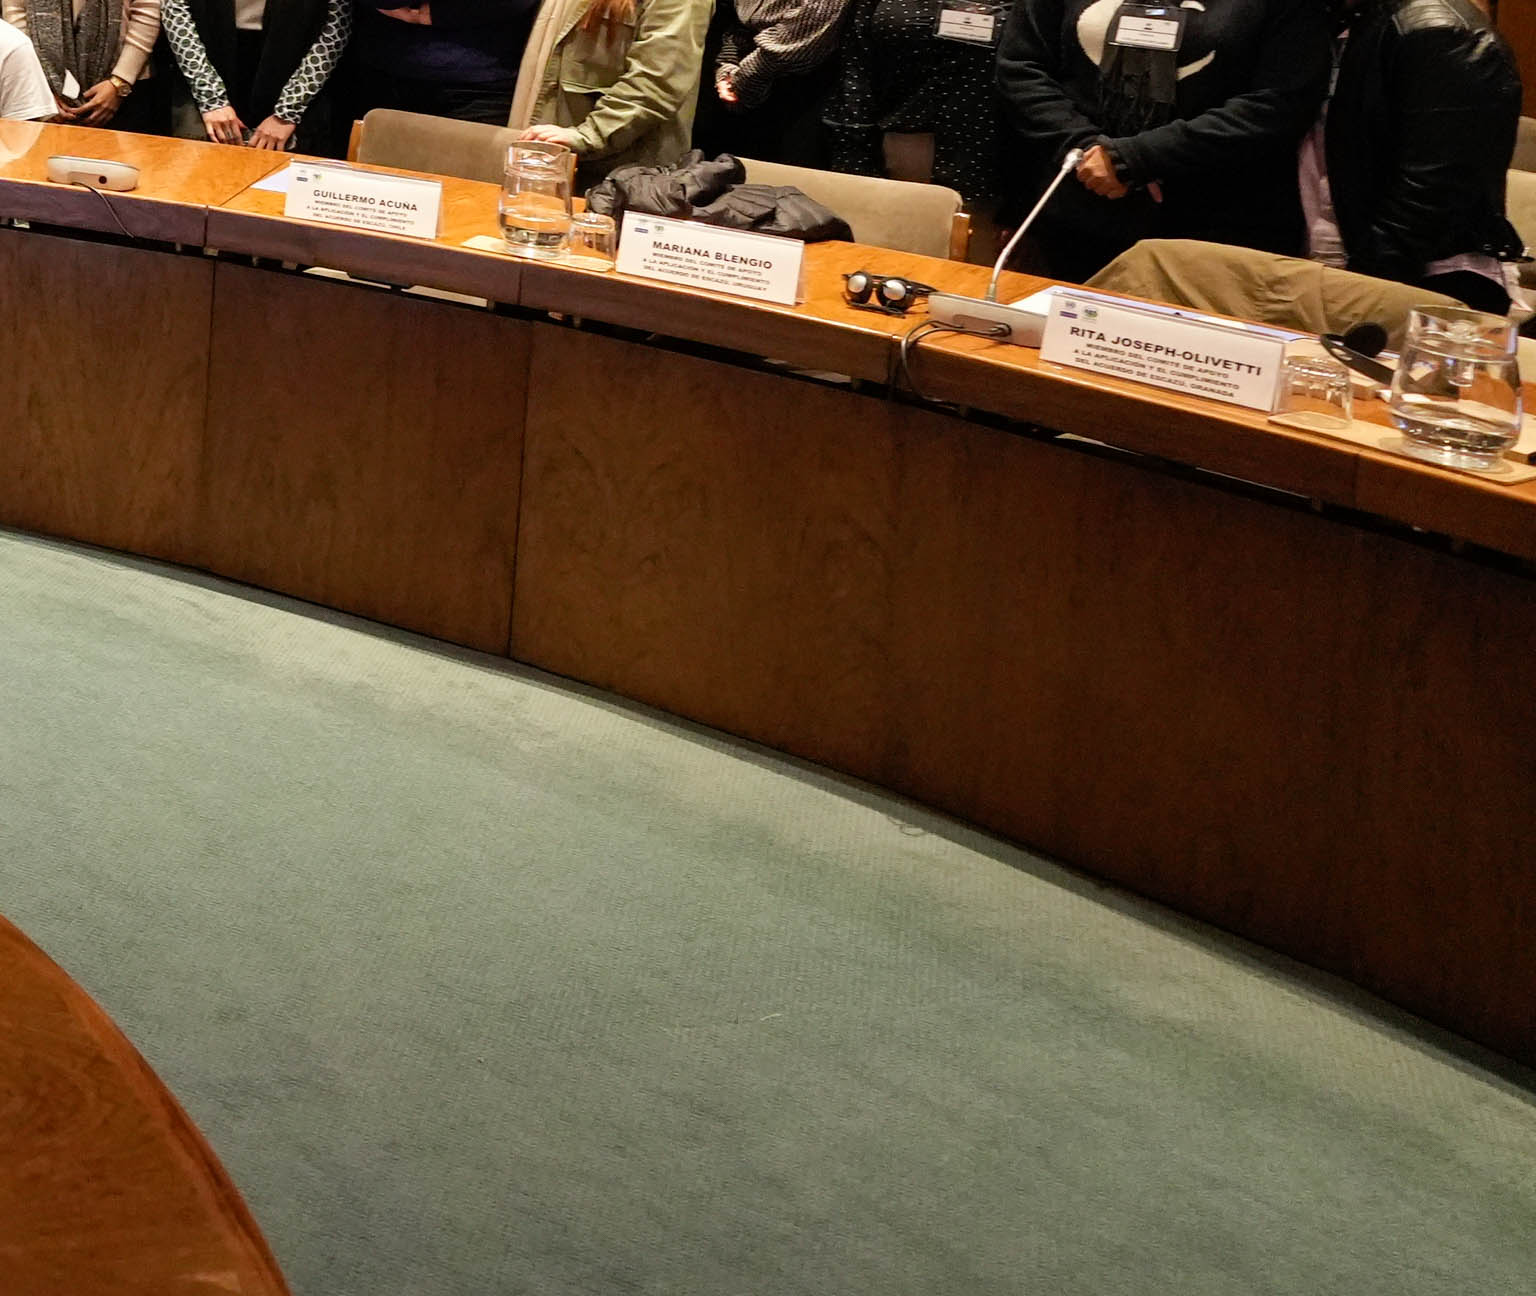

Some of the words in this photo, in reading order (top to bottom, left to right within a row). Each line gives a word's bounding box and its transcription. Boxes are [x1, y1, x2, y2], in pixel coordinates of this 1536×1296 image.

[313, 190, 376, 205] GUILLERMO
[379, 200, 418, 211] ACUÑA
[653, 242, 711, 258] MARIANA
[715, 253, 773, 270] BLENGIO
[1071, 327, 1107, 342] RITA
[1111, 335, 1261, 376] JOSEPH-OLIVETTI
